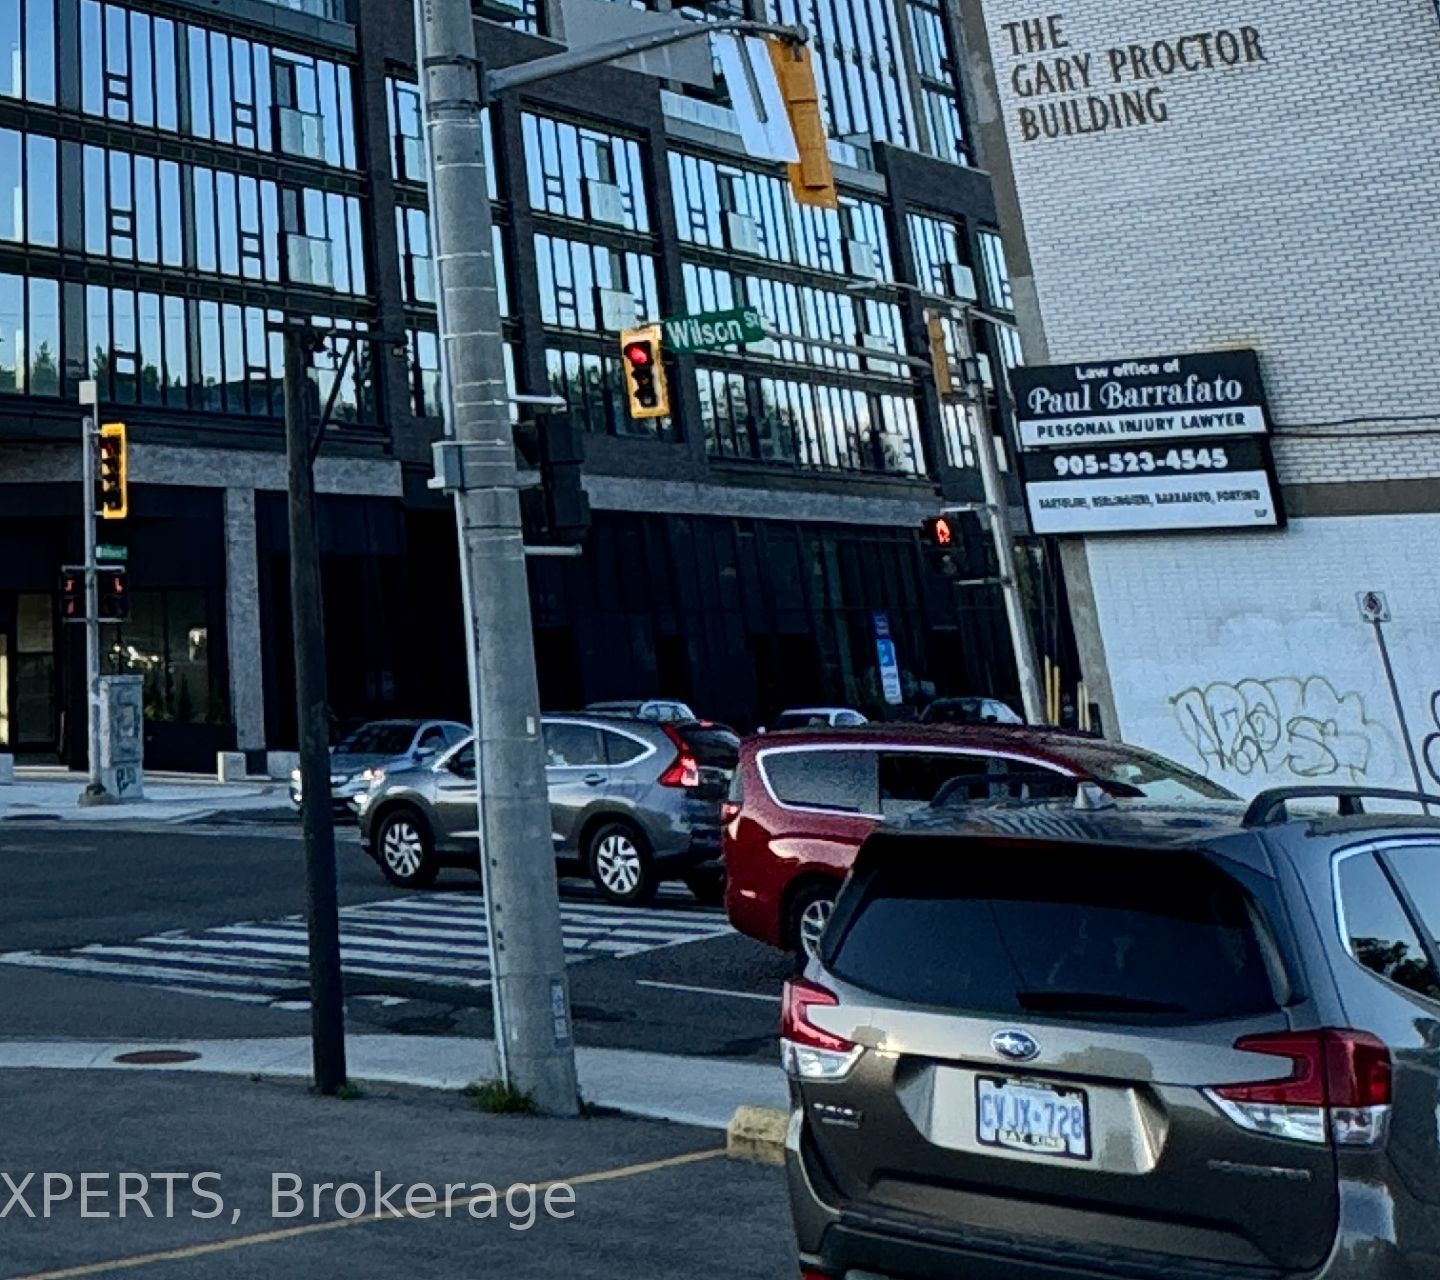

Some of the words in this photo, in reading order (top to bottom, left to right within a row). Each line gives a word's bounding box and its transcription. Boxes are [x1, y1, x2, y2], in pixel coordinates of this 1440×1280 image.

[1001, 14, 1068, 56] THE
[1011, 52, 1091, 97] GARY
[1109, 25, 1268, 83] PROCTOR
[1018, 86, 1167, 142] BUILDING
[665, 318, 743, 348] Wilson
[1075, 366, 1109, 381] Law
[1113, 362, 1159, 378] office
[1163, 358, 1181, 374] of
[1027, 382, 1092, 415] Paul
[1099, 373, 1242, 410] Barrafato
[1037, 420, 1115, 439] PERSONAL
[1120, 415, 1174, 434] INJURY
[1181, 411, 1246, 430] LAWYER
[1053, 447, 1229, 476] 905-523-4545
[1044, 1101, 1083, 1139] 728
